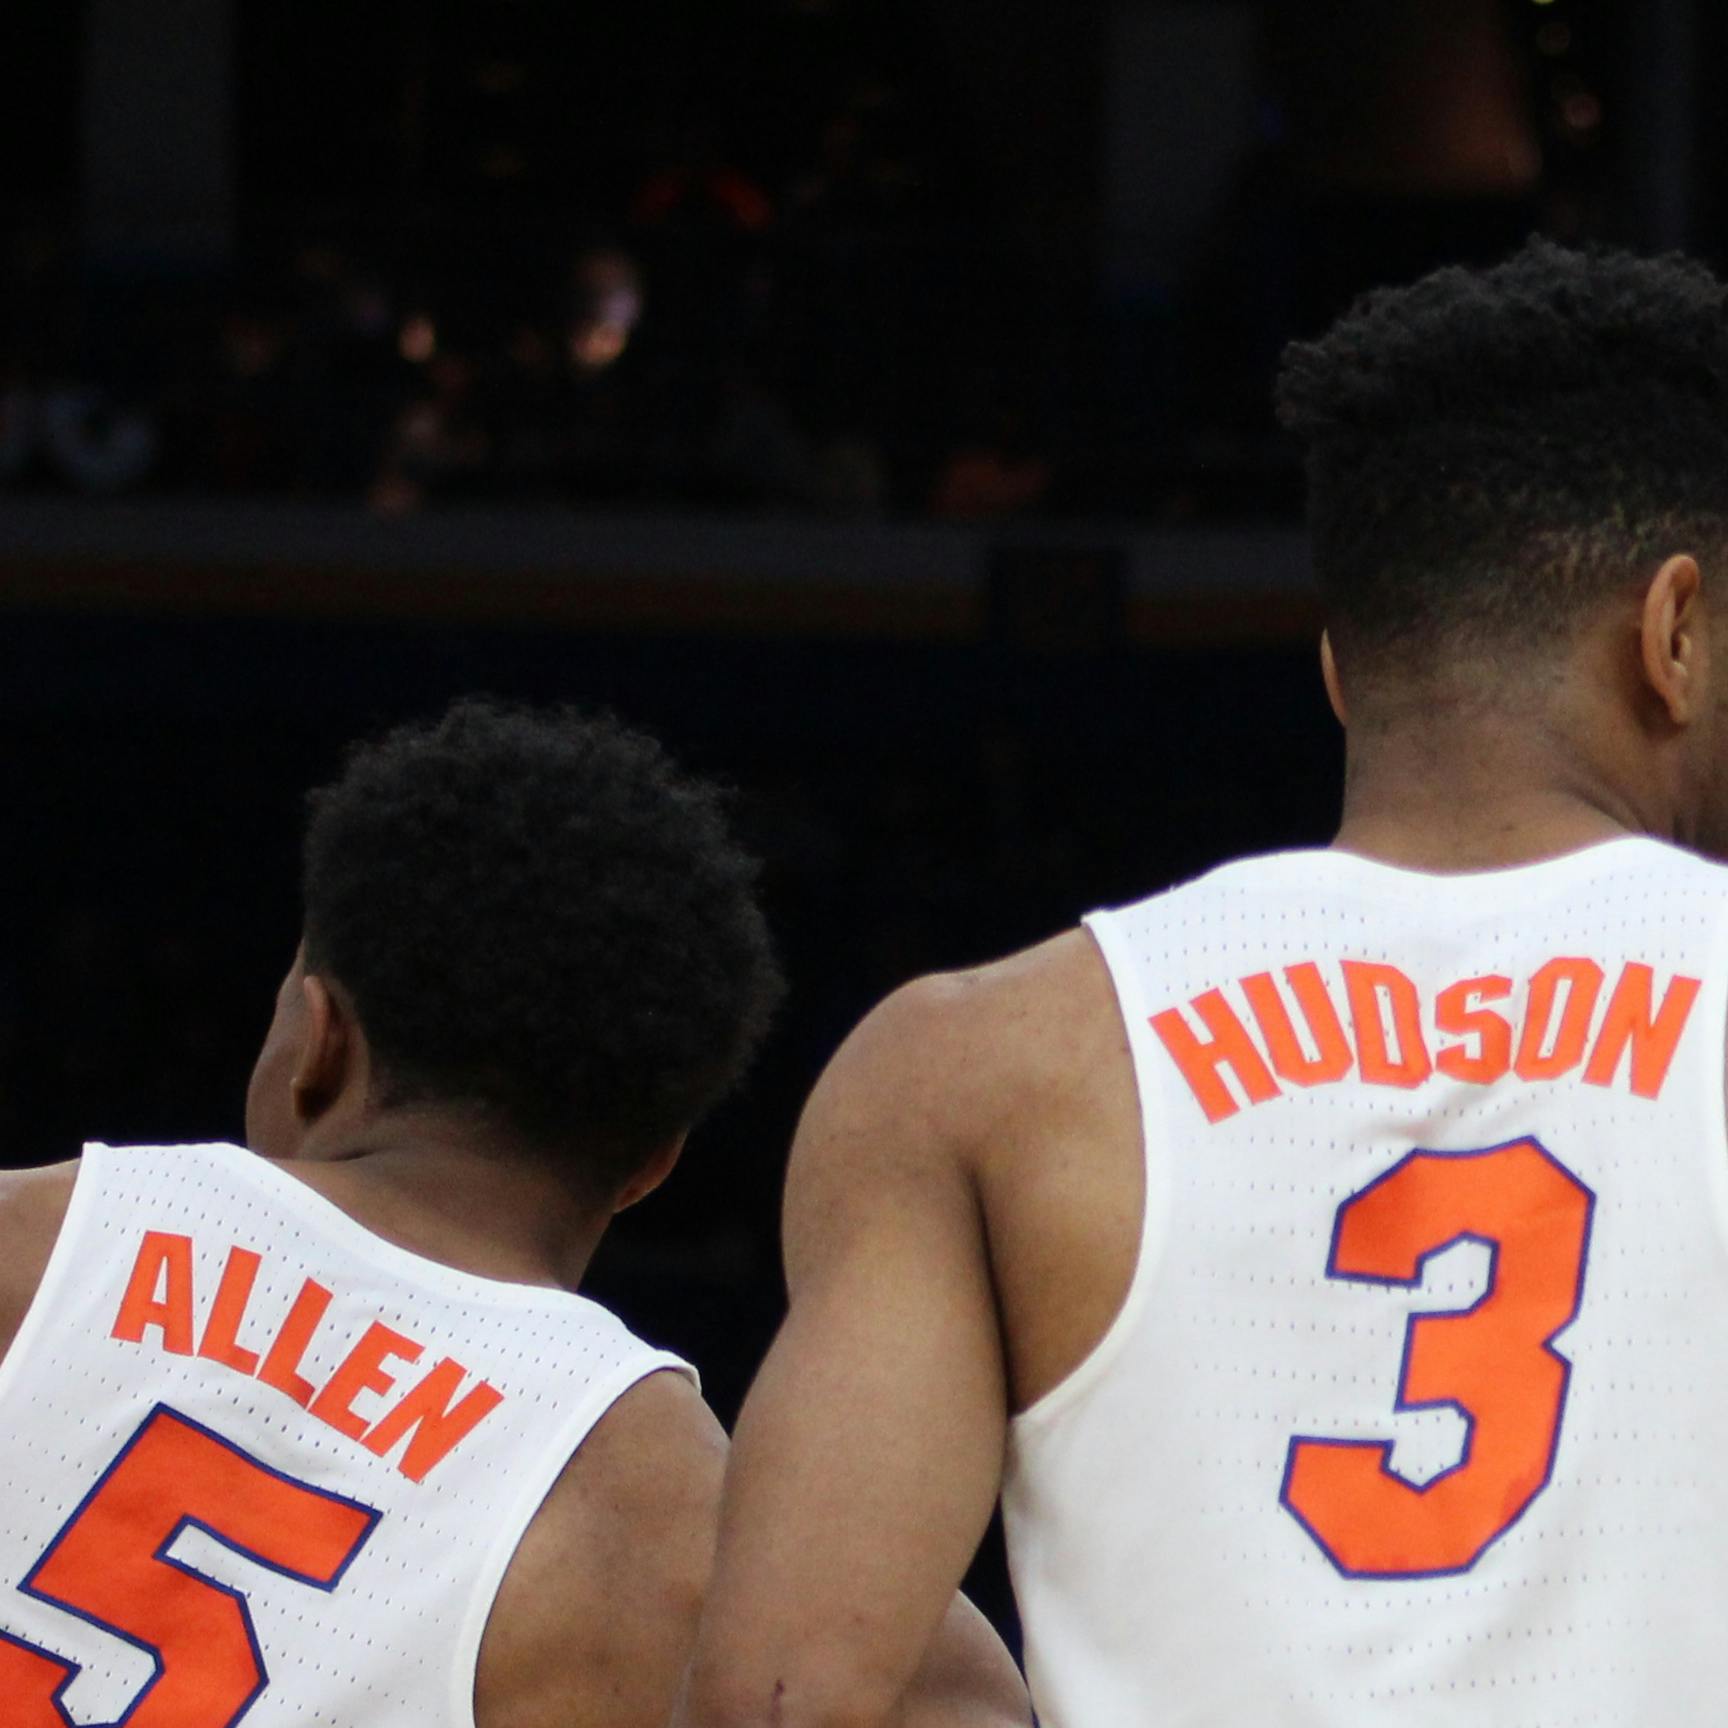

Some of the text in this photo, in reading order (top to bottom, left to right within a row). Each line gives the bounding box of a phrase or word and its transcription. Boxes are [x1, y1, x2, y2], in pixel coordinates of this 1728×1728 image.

[1147, 957, 1702, 1125] HUDSON
[111, 1230, 504, 1484] ALLEN
[1278, 1135, 1596, 1579] 3
